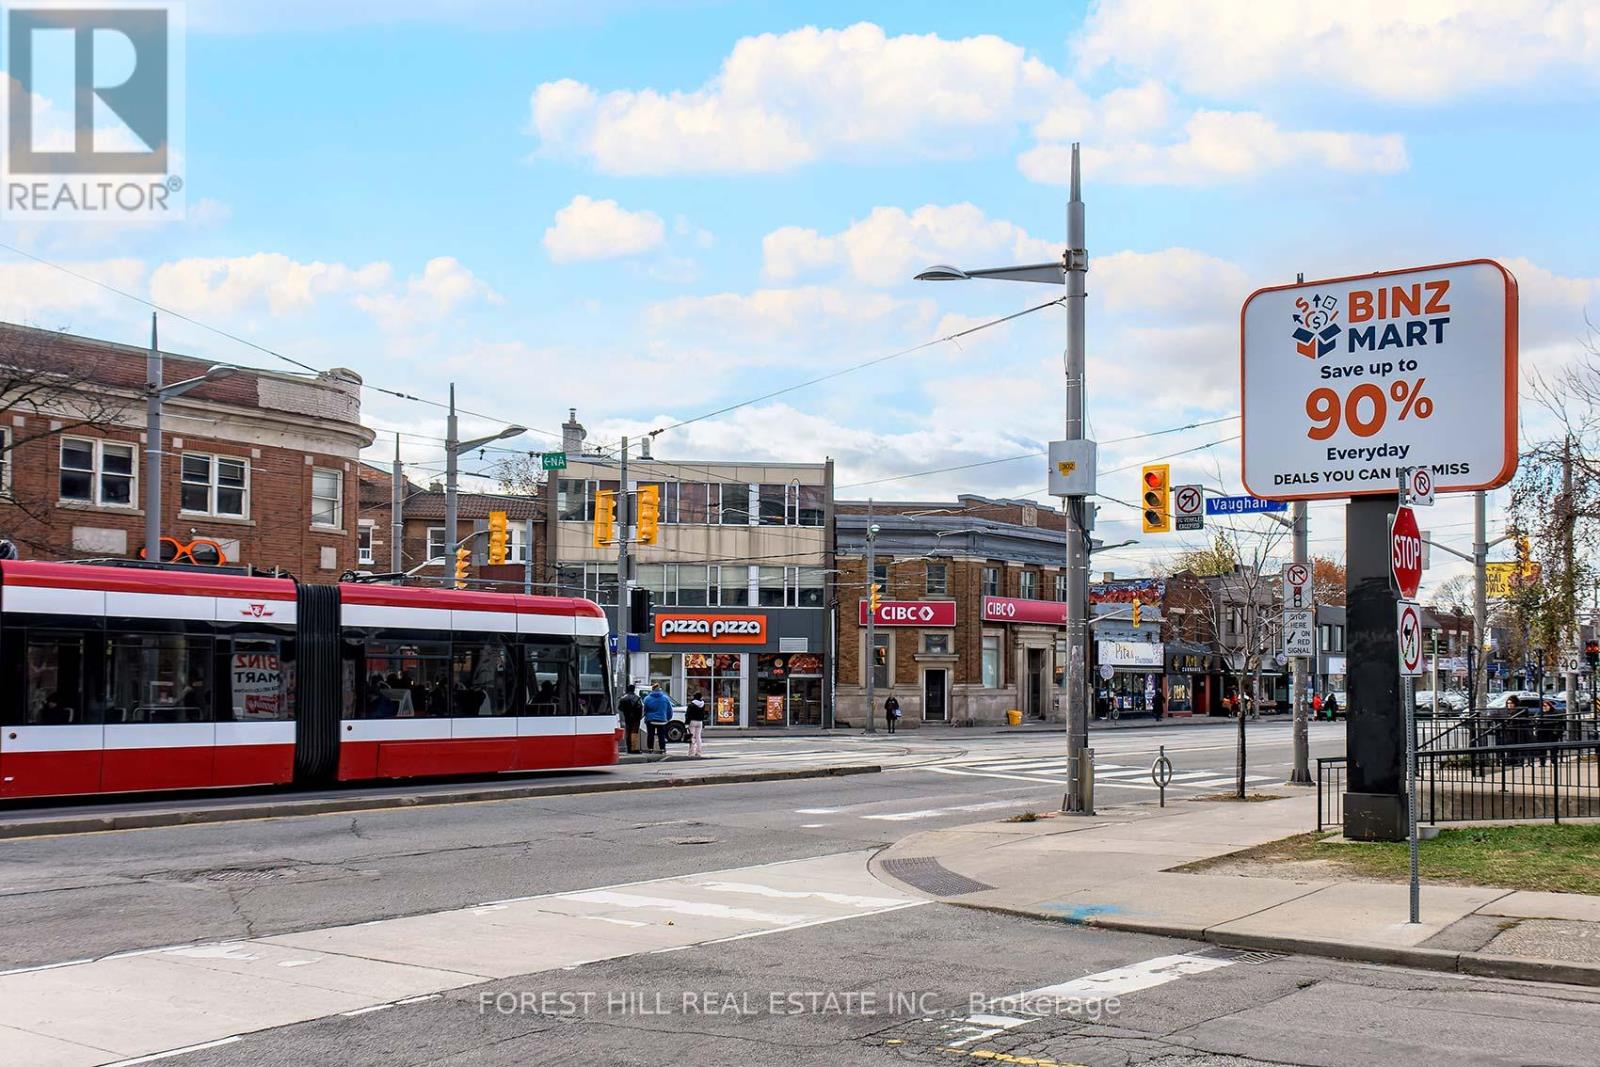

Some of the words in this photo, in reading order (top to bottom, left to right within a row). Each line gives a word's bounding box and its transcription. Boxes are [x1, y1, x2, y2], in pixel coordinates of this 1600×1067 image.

[1348, 279, 1450, 323] BINZ
[1348, 317, 1450, 353] MART
[1320, 364, 1364, 379] Save
[1369, 361, 1393, 377] up
[1398, 359, 1418, 372] to
[1306, 377, 1434, 440] 90%
[1326, 443, 1410, 462] Everyday
[1274, 472, 1319, 485] DEALS
[1323, 470, 1354, 482] YOU
[1358, 468, 1391, 480] CAN
[1431, 463, 1470, 476] MISS
[1212, 498, 1268, 512] Vaughan
[1394, 534, 1420, 570] STOP
[881, 606, 918, 620] CIBC
[987, 602, 1007, 616] CIBC
[662, 619, 709, 637] pizza
[712, 620, 761, 638] pizza
[1287, 646, 1311, 654] SIGNAL
[1297, 638, 1311, 646] RED
[1560, 657, 1578, 671] 40
